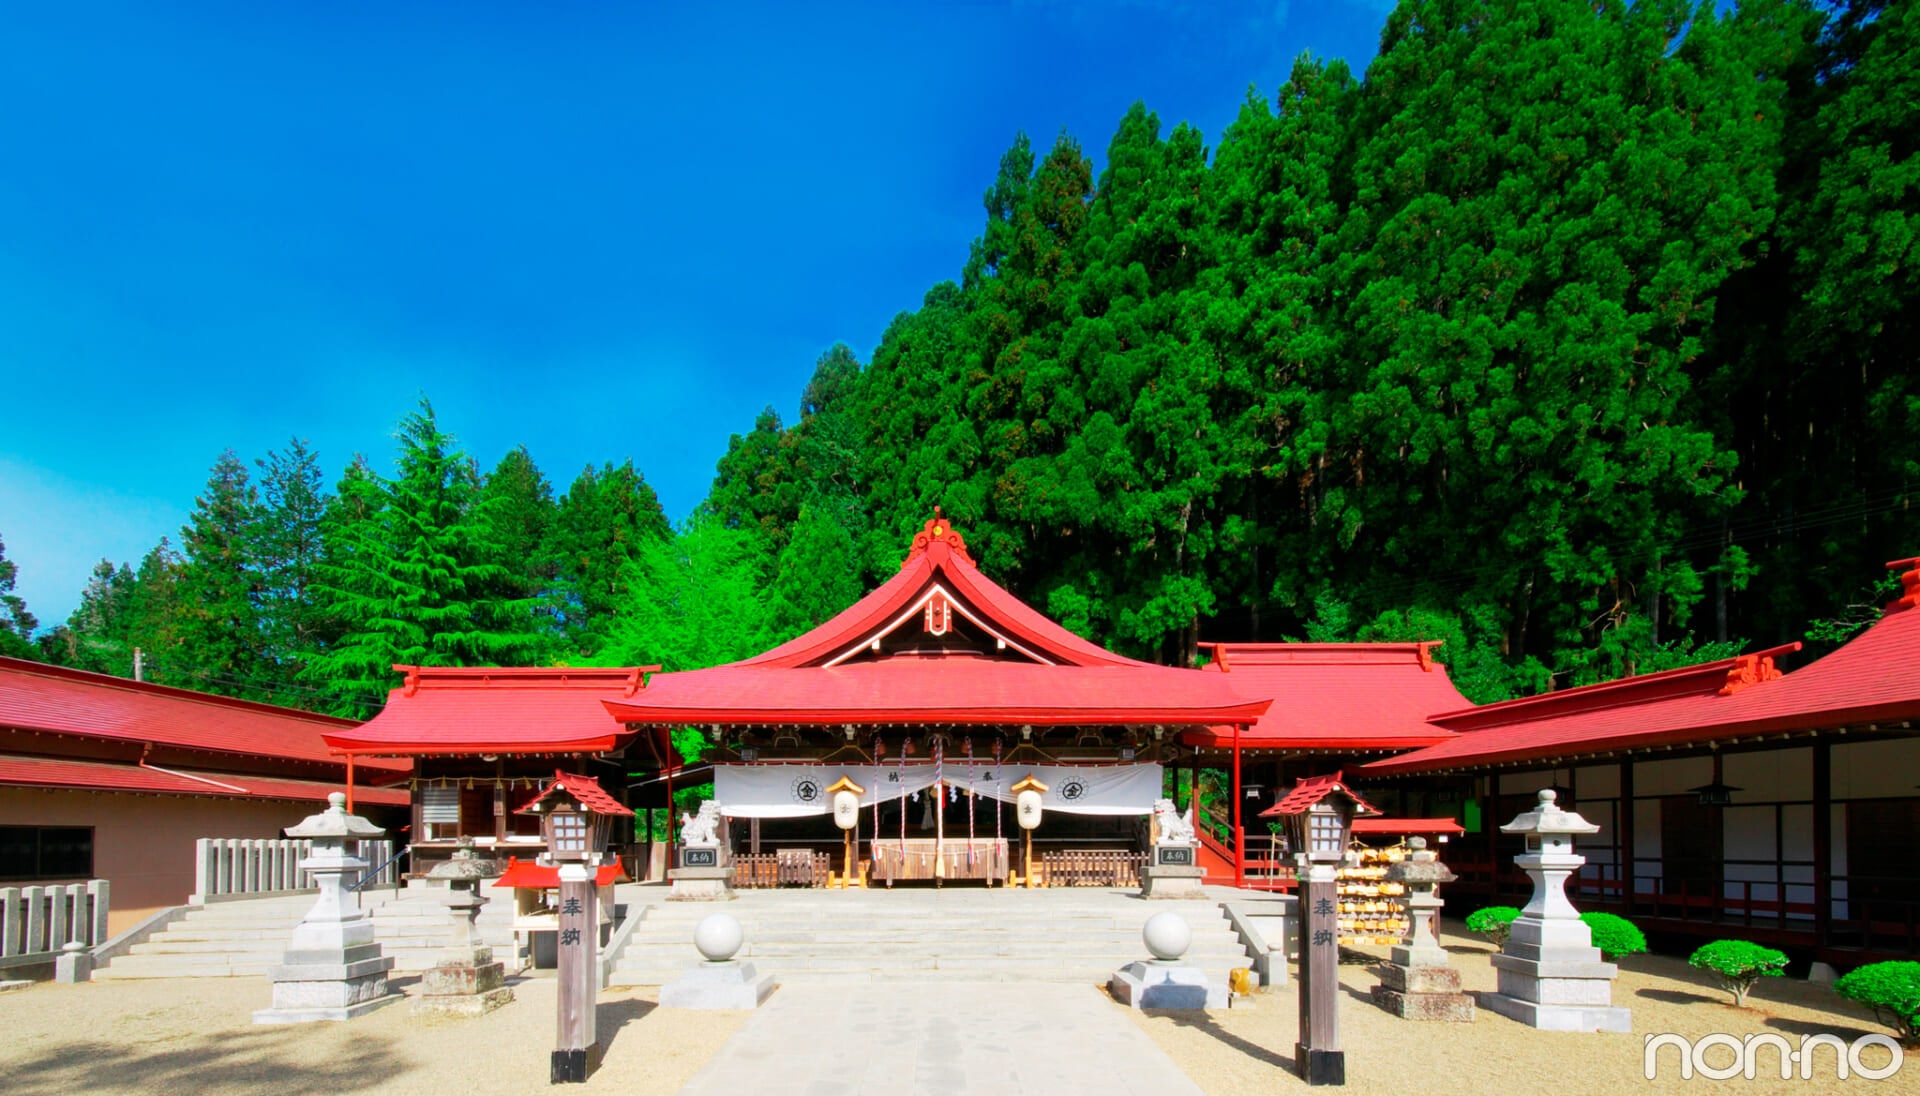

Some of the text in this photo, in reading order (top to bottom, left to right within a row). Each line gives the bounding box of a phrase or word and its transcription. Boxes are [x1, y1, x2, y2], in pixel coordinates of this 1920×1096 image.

[983, 771, 993, 781] 奉
[801, 783, 814, 798] 金
[1064, 785, 1079, 797] 金
[691, 853, 709, 862] 奉納
[1166, 851, 1184, 861] 奉納
[561, 897, 583, 946] 奉納
[1312, 897, 1334, 946] 奉納
